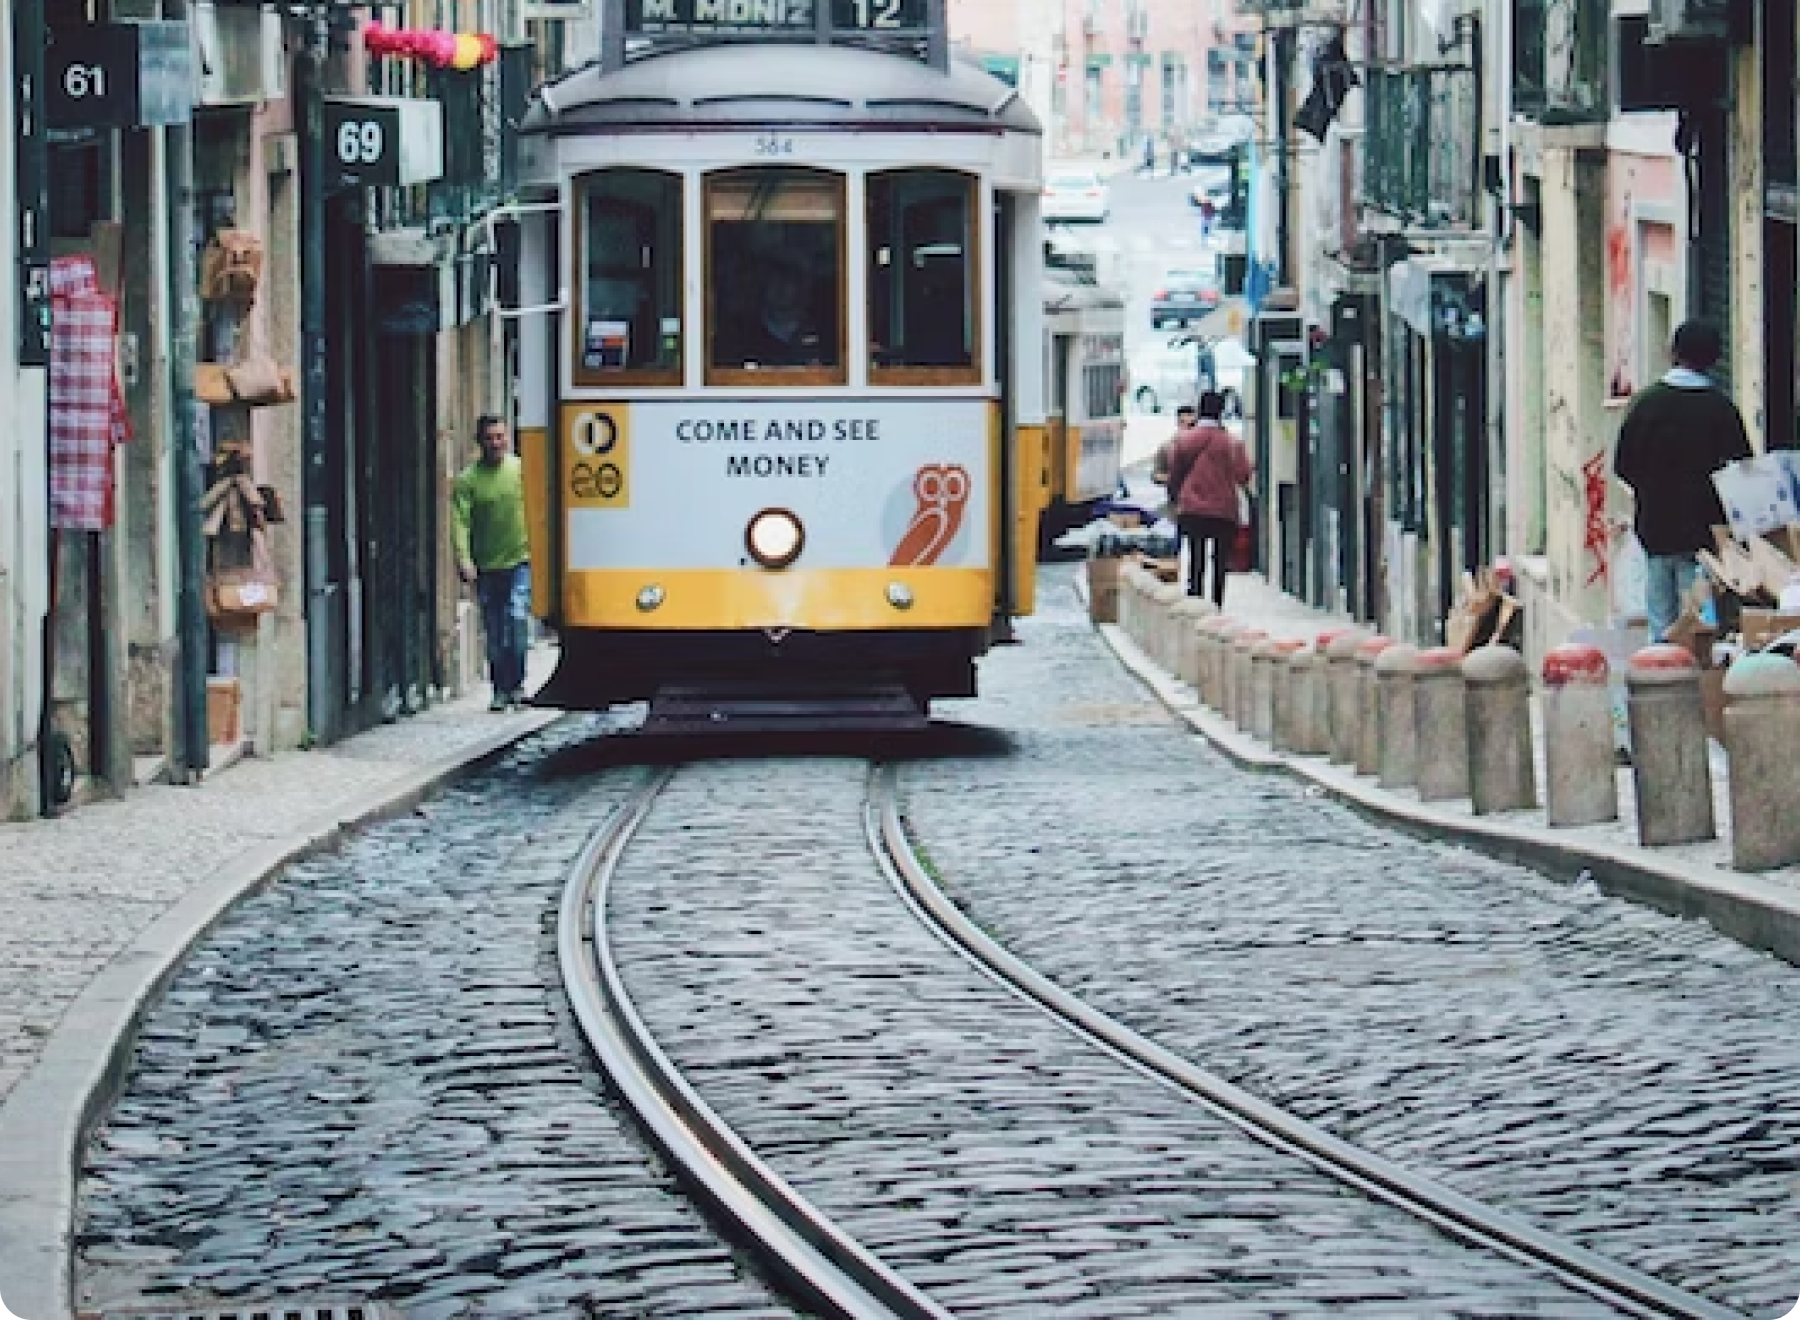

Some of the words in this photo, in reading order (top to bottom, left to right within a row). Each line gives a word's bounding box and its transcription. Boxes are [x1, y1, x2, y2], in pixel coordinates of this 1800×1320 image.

[64, 63, 106, 97] 61
[337, 121, 383, 163] 69
[675, 419, 757, 443] COME
[763, 419, 827, 443] AND
[834, 419, 881, 443] SEE
[726, 455, 831, 478] MONEY
